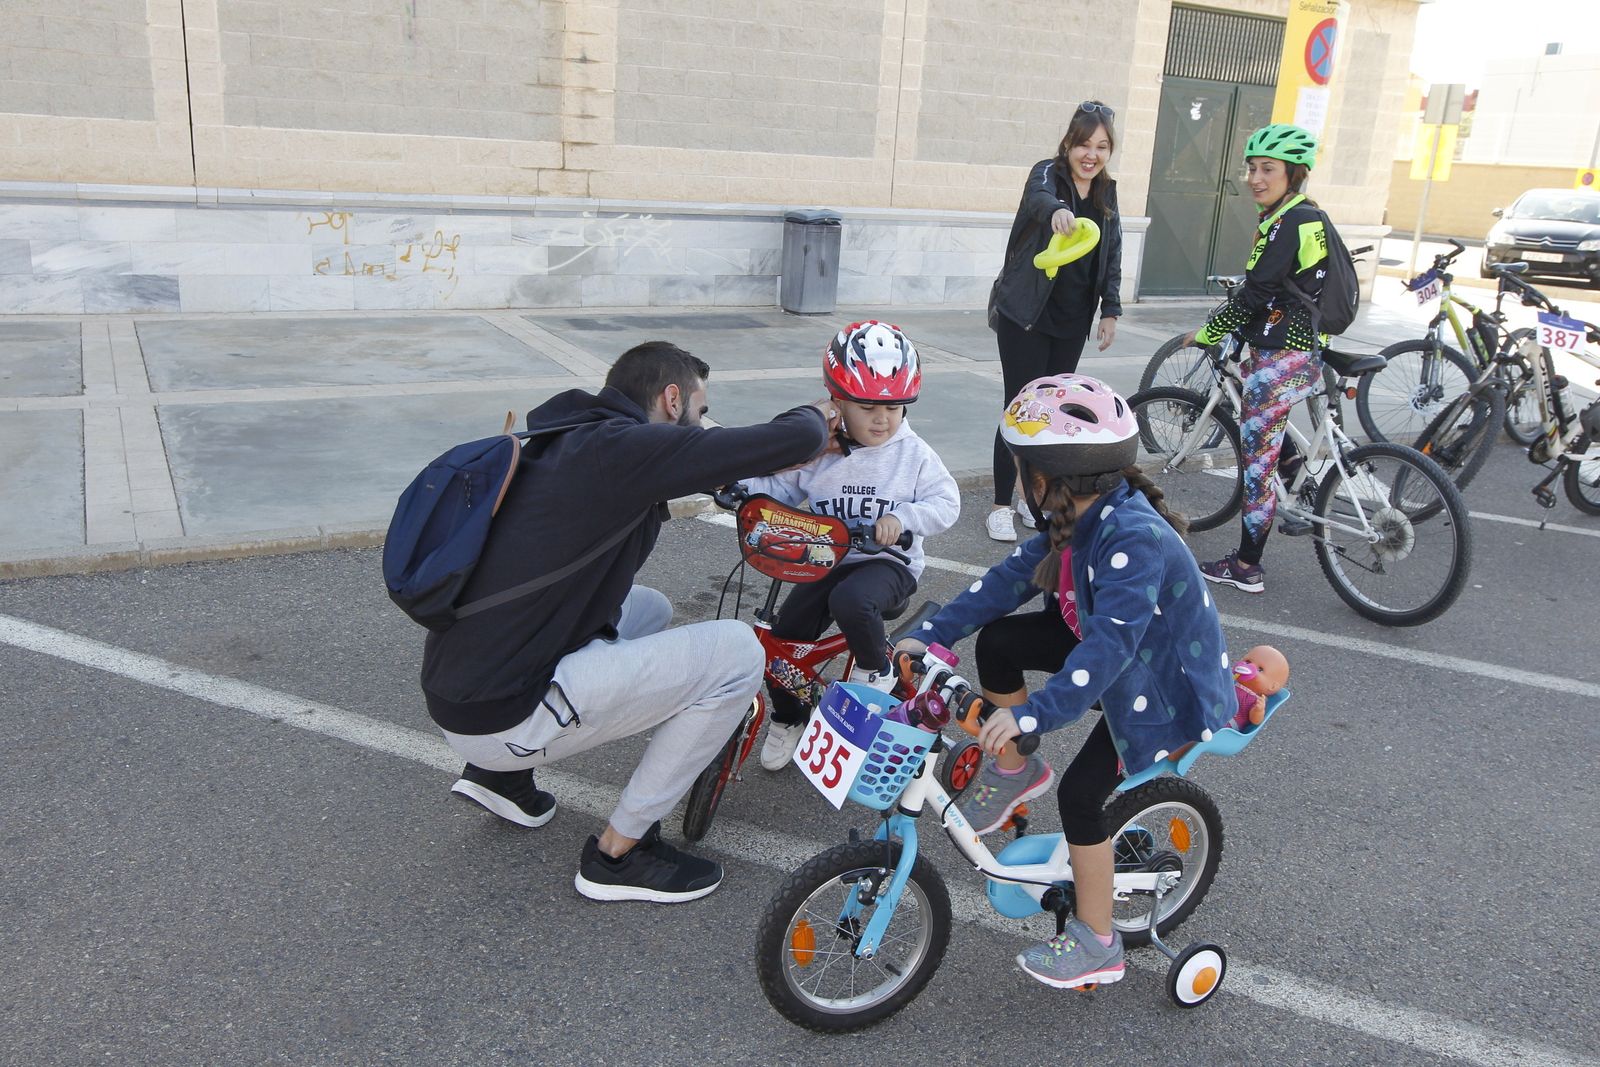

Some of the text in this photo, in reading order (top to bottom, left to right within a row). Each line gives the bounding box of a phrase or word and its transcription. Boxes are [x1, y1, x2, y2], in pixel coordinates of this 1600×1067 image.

[1417, 283, 1437, 304] 304
[1542, 327, 1580, 350] 387
[842, 485, 876, 496] COLLEGE
[771, 512, 820, 537] CHAMPION
[799, 719, 851, 789] 335
